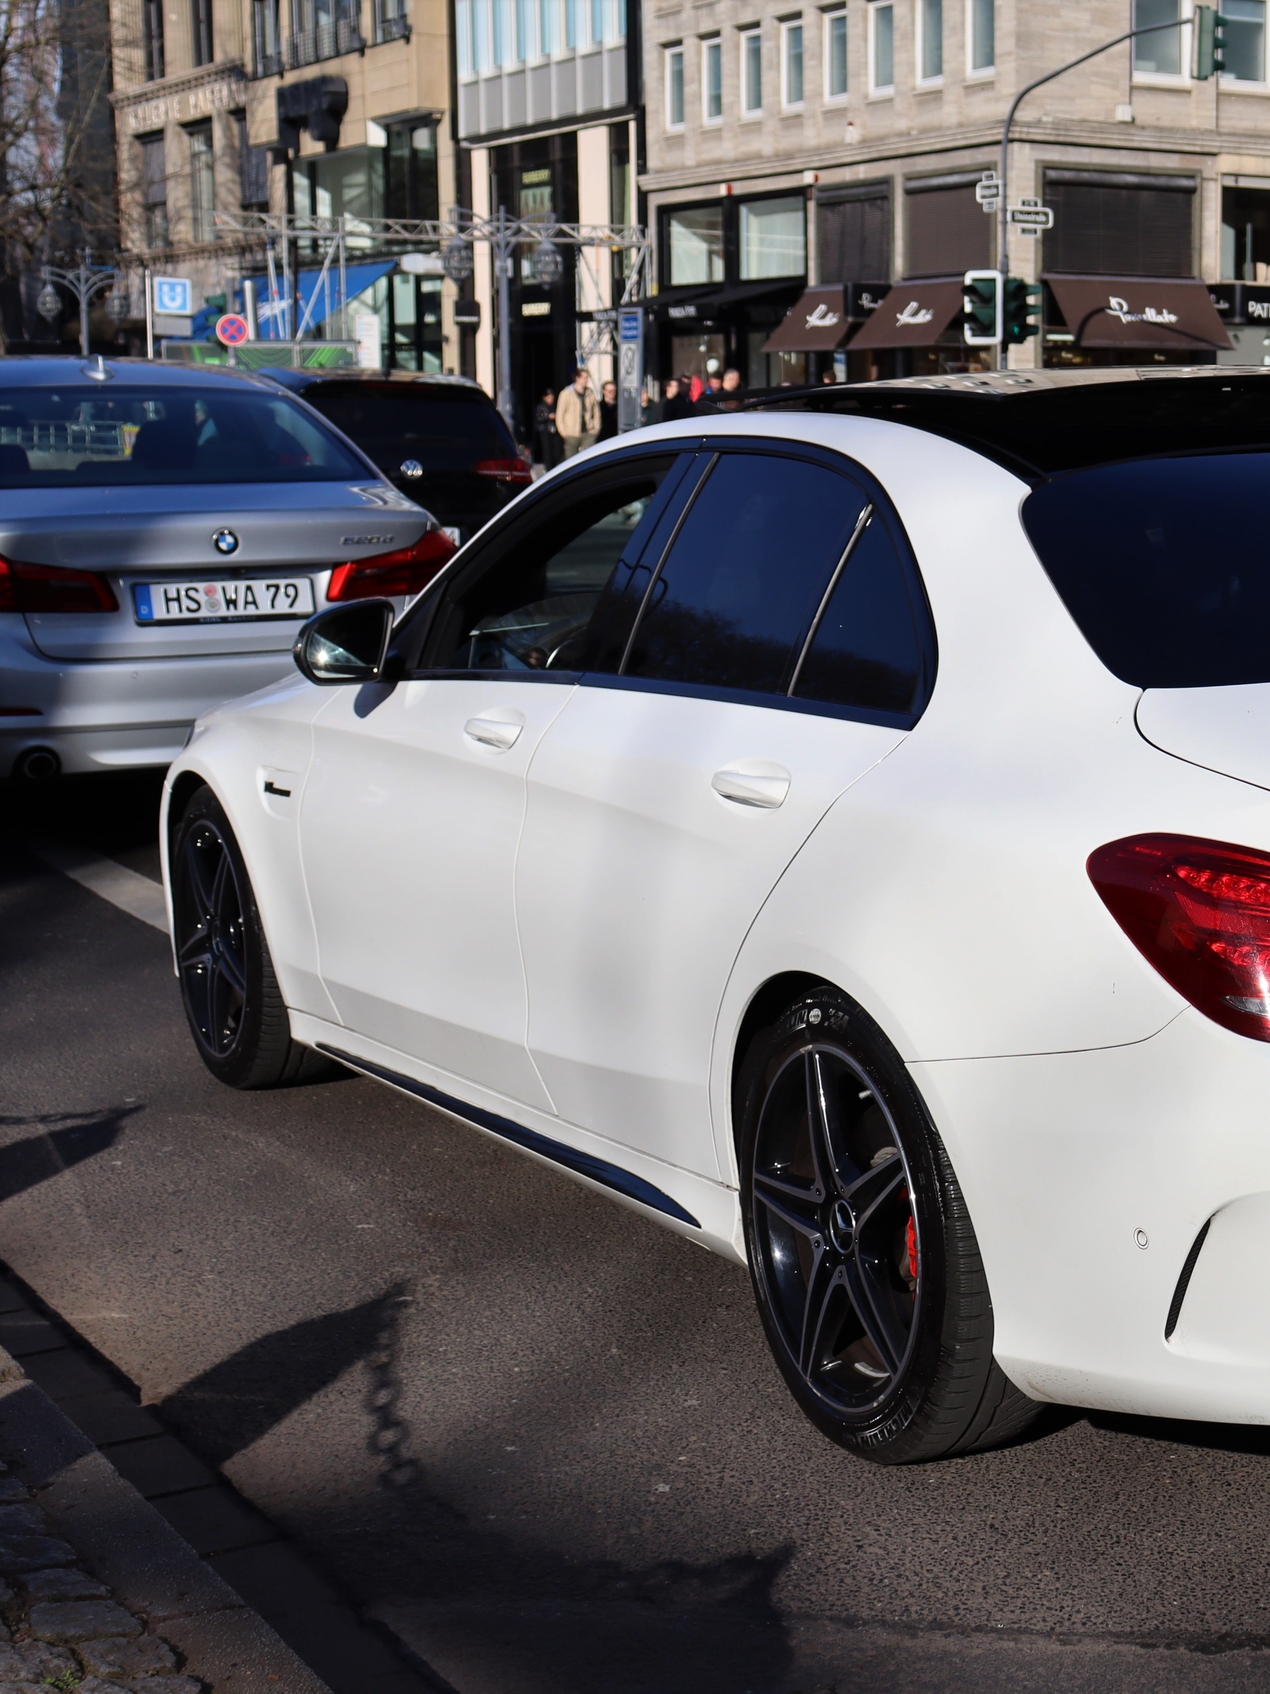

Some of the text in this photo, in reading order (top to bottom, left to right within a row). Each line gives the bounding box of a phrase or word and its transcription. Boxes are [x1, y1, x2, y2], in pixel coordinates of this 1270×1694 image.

[161, 586, 202, 615] HS
[220, 584, 259, 611] WA
[265, 583, 299, 609] 79
